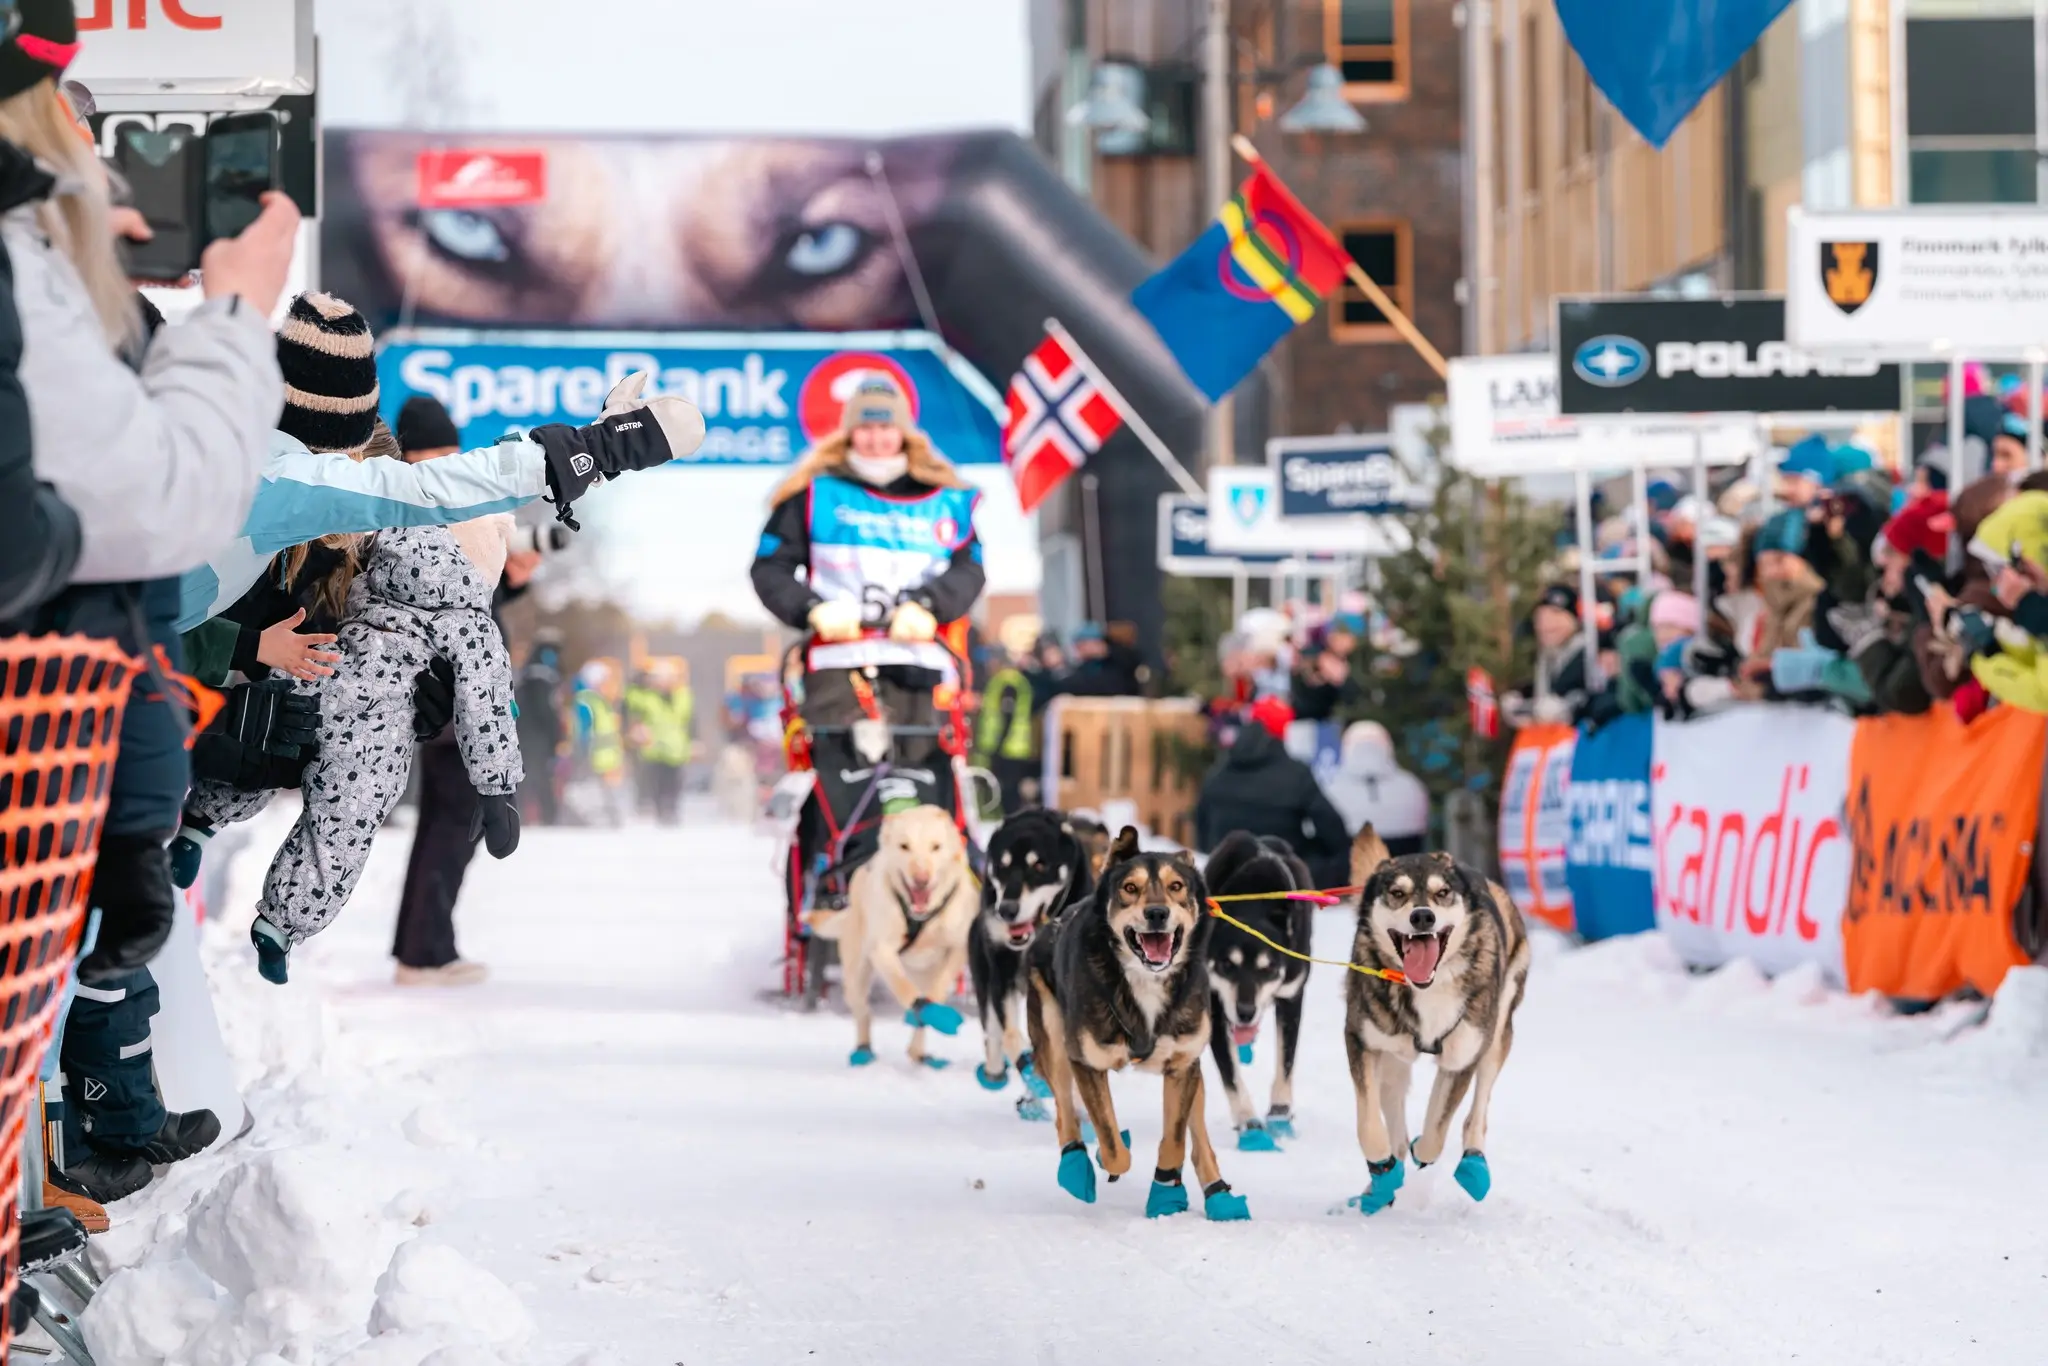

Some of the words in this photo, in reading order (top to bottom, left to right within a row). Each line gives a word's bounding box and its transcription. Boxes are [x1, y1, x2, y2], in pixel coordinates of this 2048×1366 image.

[400, 350, 789, 424] SpareBank
[615, 421, 643, 432] HESTRA
[1652, 763, 1839, 941] candic
